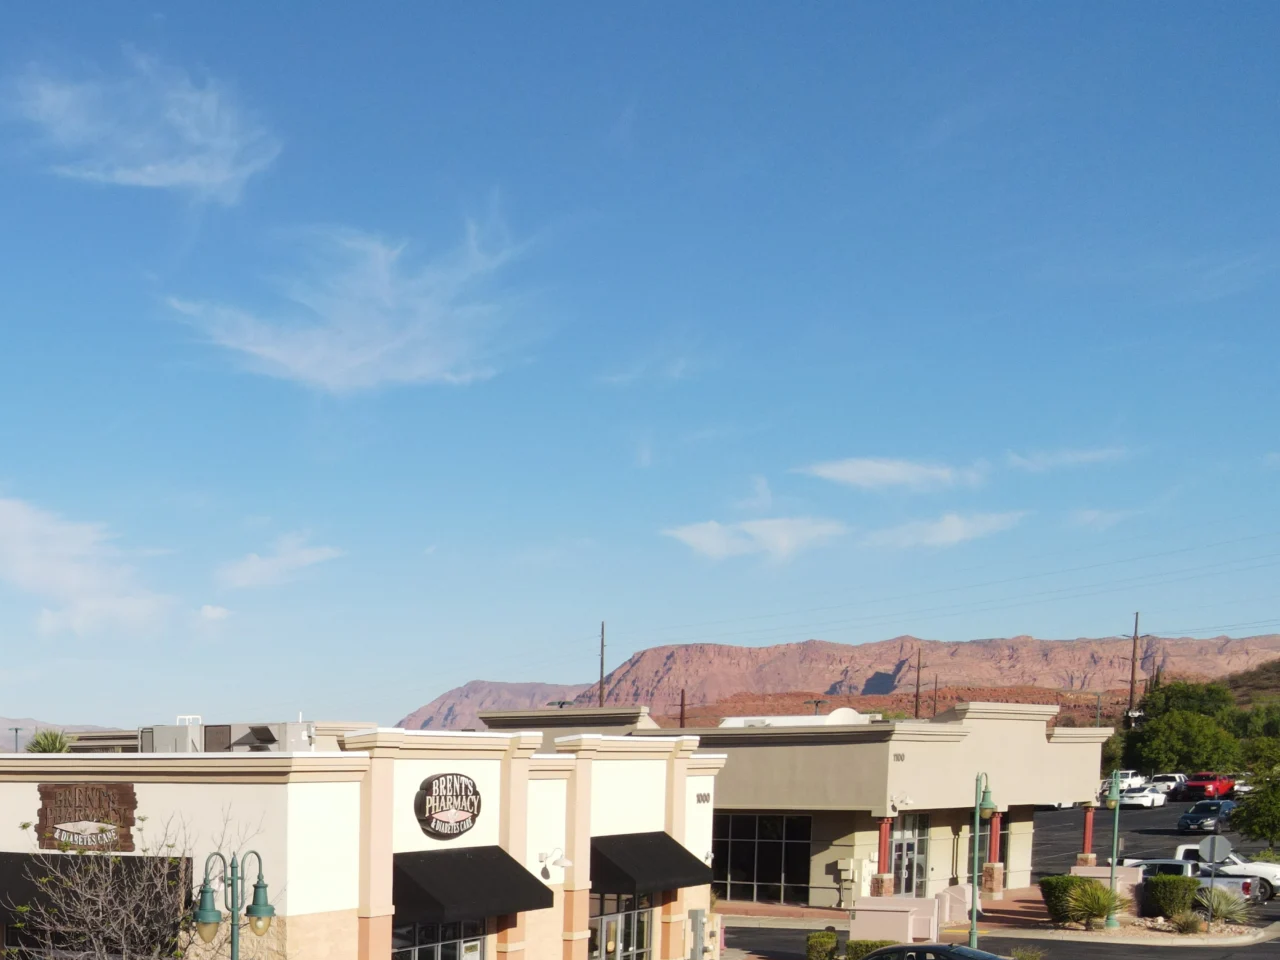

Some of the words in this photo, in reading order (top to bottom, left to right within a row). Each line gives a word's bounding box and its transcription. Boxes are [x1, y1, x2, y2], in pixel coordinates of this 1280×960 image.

[432, 775, 474, 796] BRENT'S
[54, 787, 119, 807] BRENT'S
[425, 795, 479, 817] PHARMACY
[435, 820, 460, 833] DIABETES
